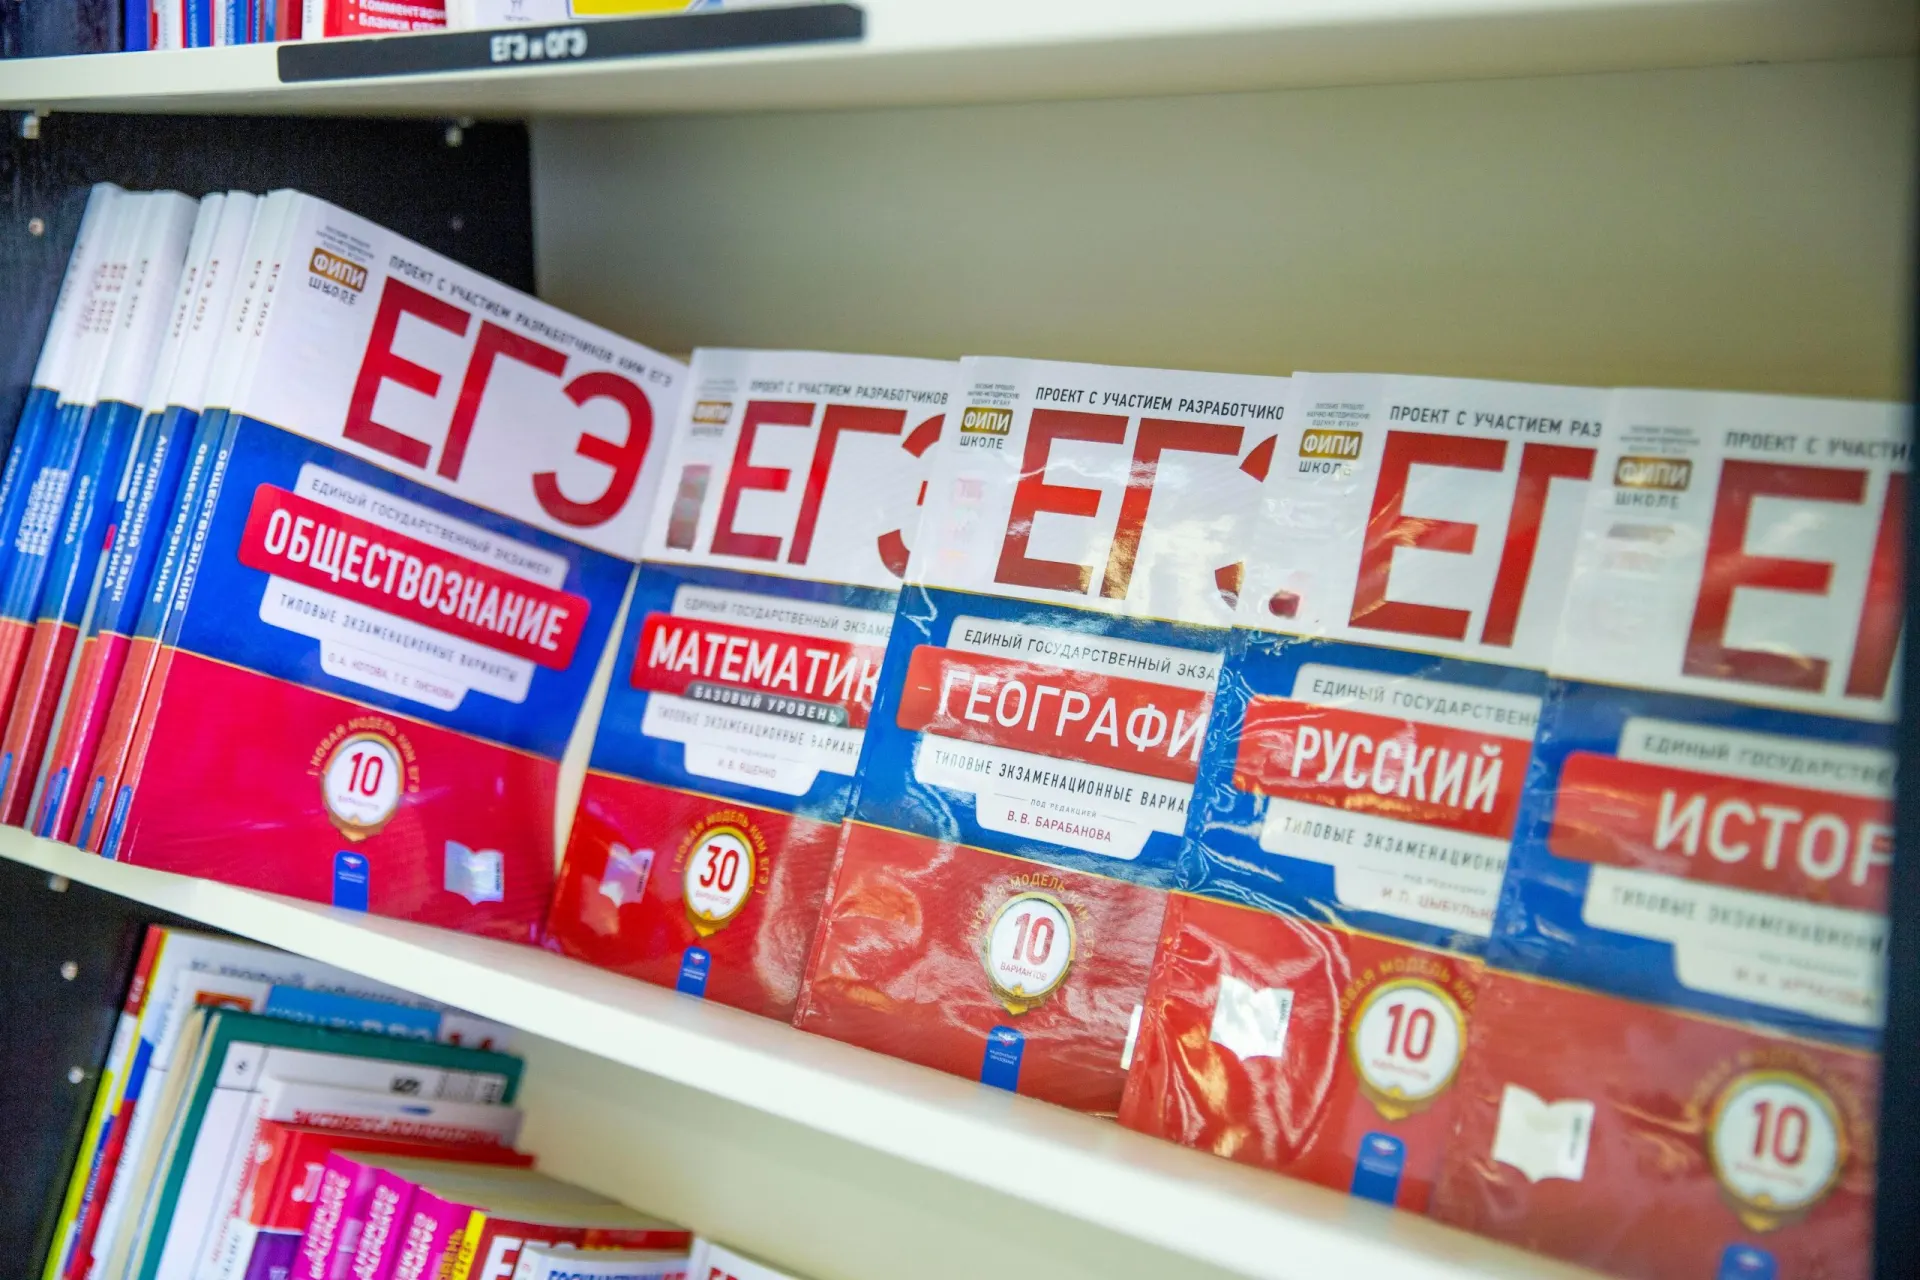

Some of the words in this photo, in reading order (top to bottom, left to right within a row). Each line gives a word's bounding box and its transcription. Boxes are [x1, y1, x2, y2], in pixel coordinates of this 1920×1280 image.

[491, 34, 528, 62] ЕГЭ
[530, 39, 542, 58] и
[545, 28, 587, 59] ОГЭ
[312, 252, 366, 290] ФИПИ
[388, 254, 434, 285] ПРОЕКТ
[343, 276, 657, 528] ЕГЭ
[857, 384, 949, 406] РАЗРАБОТЧИКОВ
[1035, 385, 1085, 404] ПРОЕКТ
[1089, 390, 1098, 405] С
[1102, 393, 1173, 412] УЧАСТИЕМ
[1178, 398, 1285, 421] РАЗРАБОТЧИКО
[963, 410, 1011, 432] ФИПИ
[1390, 405, 1450, 425] ПРОЕКТ
[1456, 410, 1467, 425] С
[1474, 413, 1563, 435] УЧАСТИЕМ
[1569, 420, 1603, 439] РАЗ
[960, 435, 1004, 450] ШКОЛЕ
[1303, 434, 1360, 456] ФИПИ
[1724, 430, 1798, 453] ПРОЕКТ
[1806, 436, 1818, 455] С
[126, 435, 168, 550] АНГЛИЙСКИЙ
[102, 462, 145, 590] ИНФОРМАТИКА
[151, 442, 208, 604] ОБЩЕСТВОЗНАНИЕ
[173, 449, 229, 613] ОБЩЕСТВОЗНАНИЕ
[312, 477, 368, 510] ЕДИНЫЙ
[371, 500, 490, 554] ГОСУДАРСТВЕННЫЙ
[1348, 430, 1598, 649] ЕГ
[109, 553, 133, 603] ЯЗЫК
[264, 509, 568, 652] ОБЩЕСТВОЗНАНИЕ
[280, 594, 336, 623] ТИПОВЫЕ
[964, 629, 1023, 650] ЕДИНЫЙ
[1028, 638, 1171, 675] ГОСУДАРСТВЕННЫЙ
[695, 683, 761, 709] БАЗОВЫЙ
[769, 696, 838, 722] УРОВЕНЬ
[1313, 679, 1385, 704] ЕДИНЫЙ
[939, 669, 1209, 762] ГЕОГРАФИ
[348, 751, 384, 797] 10
[934, 749, 993, 775] ТИПОВЫЕ
[998, 763, 1134, 804] ЭКЗАМЕНАЦИОННЫЕ
[1291, 726, 1503, 814] РУССКИЙ
[1007, 811, 1018, 822] В.
[1020, 813, 1031, 825] В.
[1035, 816, 1112, 843] БАРАБАНОВА
[1031, 799, 1046, 809] ПОД
[1050, 801, 1097, 819] РЕДАКЦИЕЙ
[1284, 816, 1355, 846] ТИПОВЫЕ
[700, 844, 740, 892] 30
[1010, 873, 1065, 892] МОДЕЛЬ
[1012, 912, 1055, 966] 10
[1000, 962, 1048, 982] ВАРИАНТОВ
[1387, 1003, 1436, 1061] 10
[1752, 1101, 1810, 1168] 10
